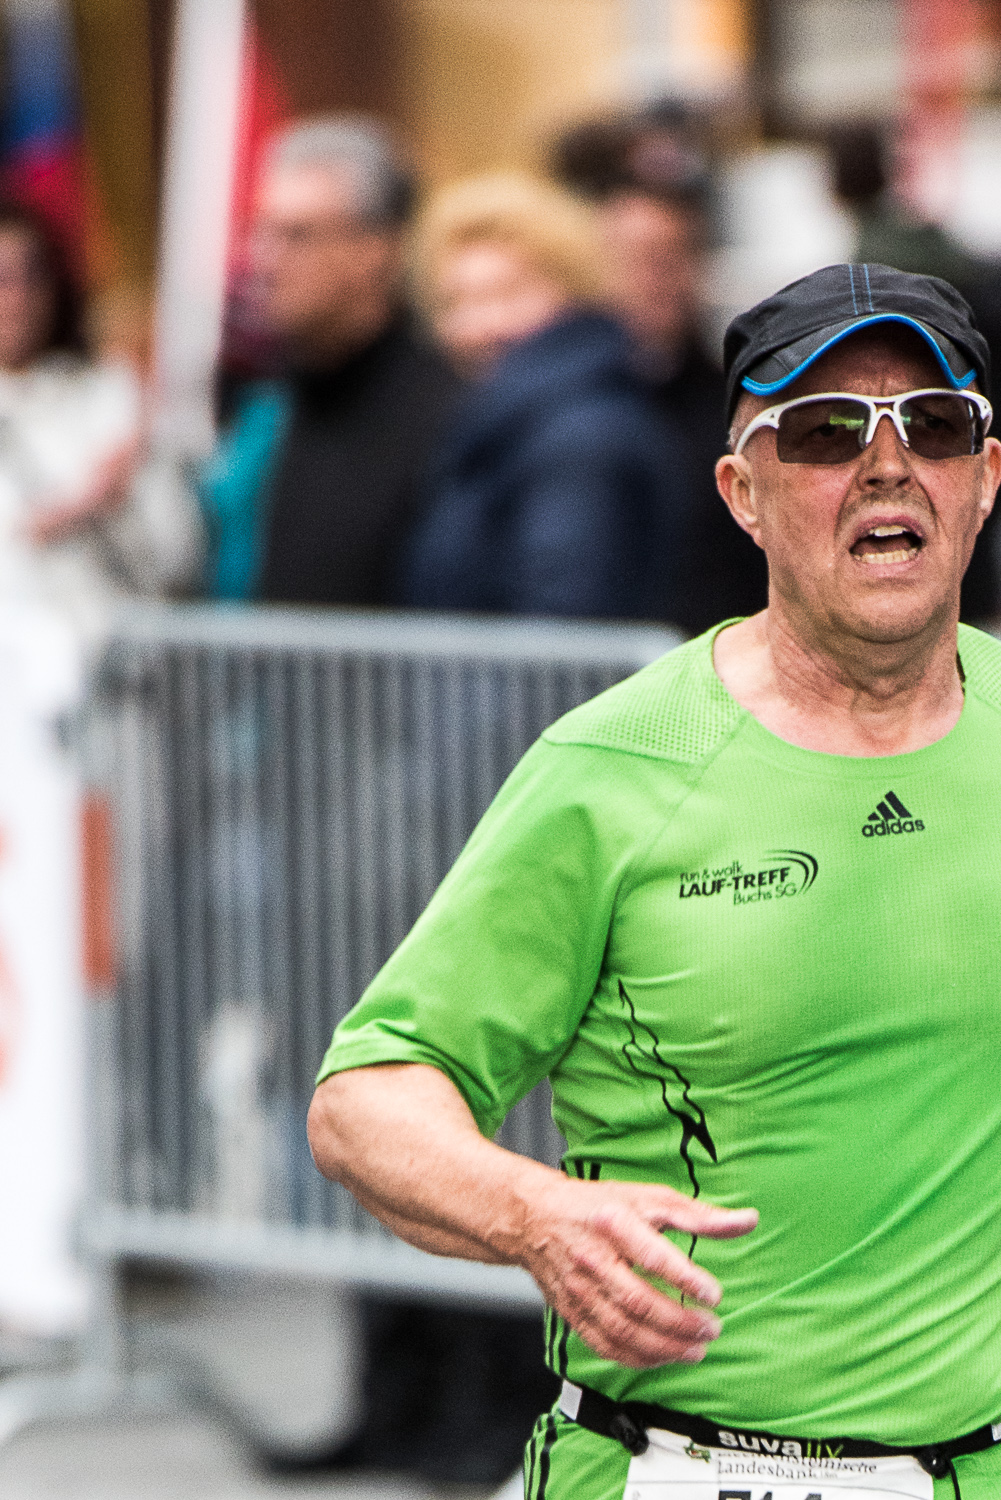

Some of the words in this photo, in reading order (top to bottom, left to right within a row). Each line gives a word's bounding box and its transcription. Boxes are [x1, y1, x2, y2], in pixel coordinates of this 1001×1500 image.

[862, 819, 925, 837] adidas
[712, 861, 742, 877] walk
[679, 867, 790, 898] LAUF-TREFF
[733, 885, 772, 905] Buchs
[775, 882, 797, 898] SG
